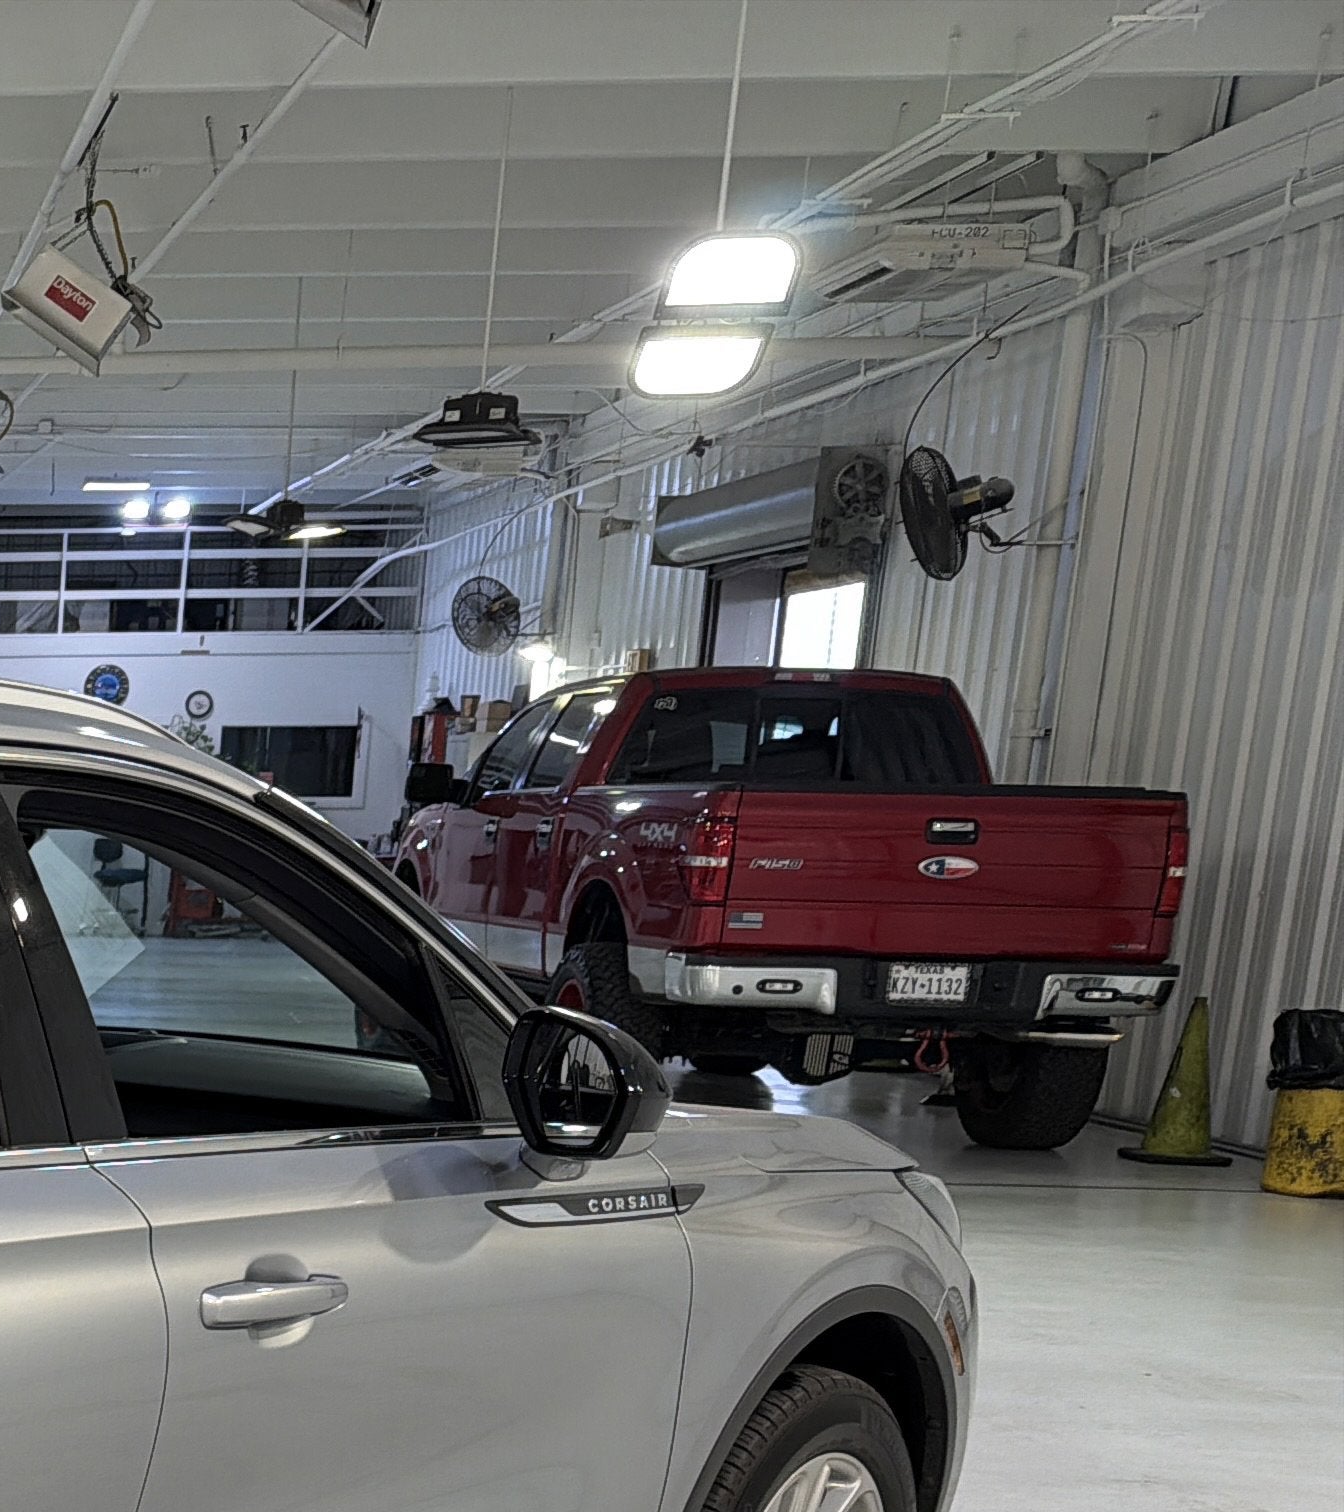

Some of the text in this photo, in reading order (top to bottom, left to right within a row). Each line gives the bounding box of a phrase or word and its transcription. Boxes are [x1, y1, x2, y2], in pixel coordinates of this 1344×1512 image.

[52, 277, 93, 311] Dayton
[915, 966, 945, 975] TEXAS
[588, 1193, 668, 1213] CORSAIR
